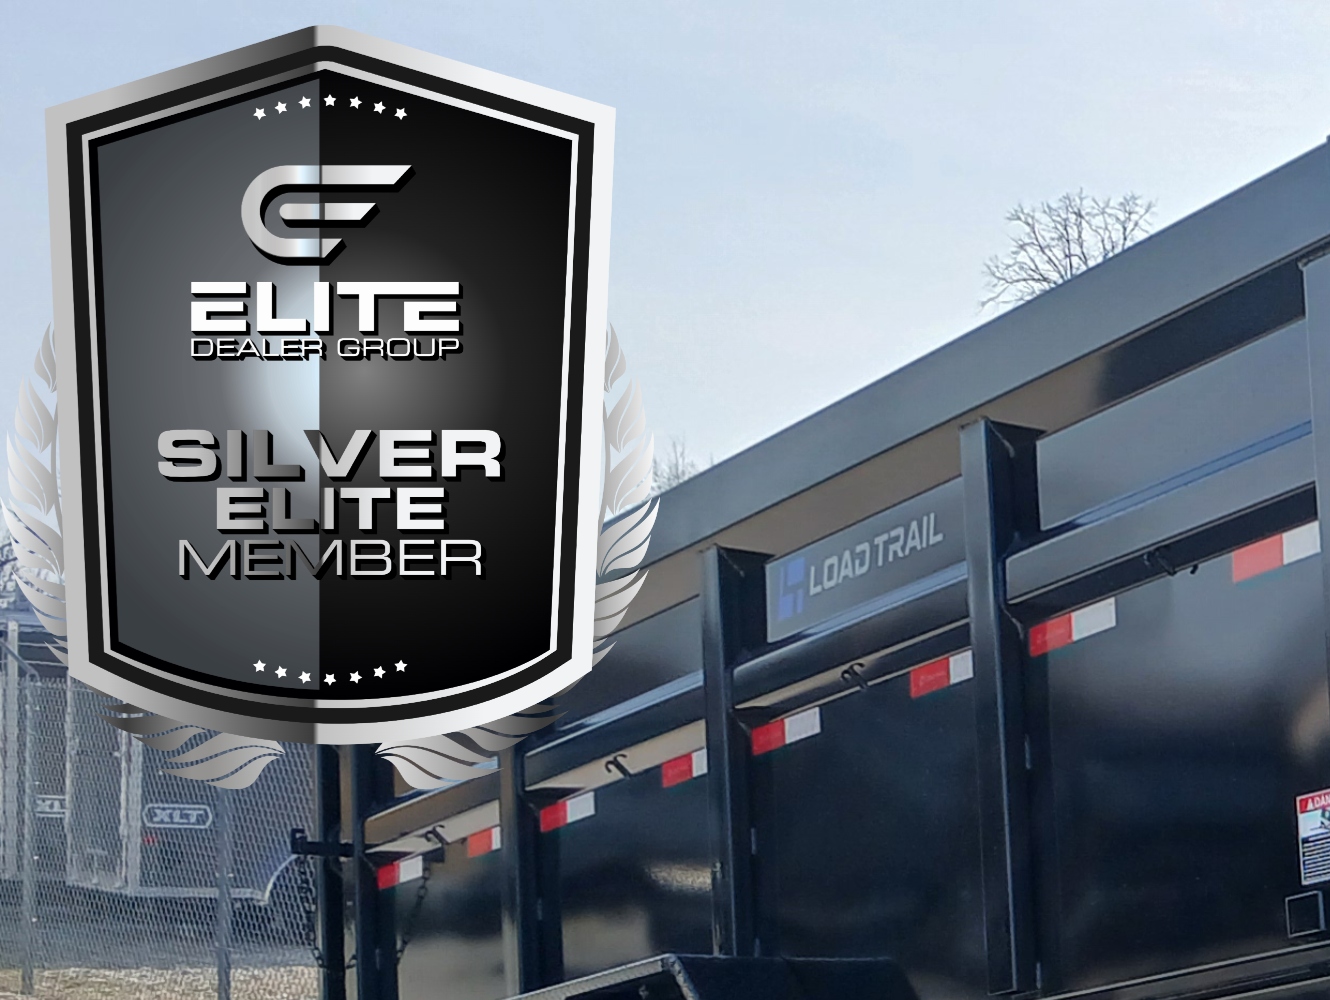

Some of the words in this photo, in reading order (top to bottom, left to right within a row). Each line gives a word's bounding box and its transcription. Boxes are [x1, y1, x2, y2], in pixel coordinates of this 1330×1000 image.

[809, 542, 870, 596] LOAD
[873, 512, 943, 567] TRAIL
[152, 808, 205, 823] XLT
